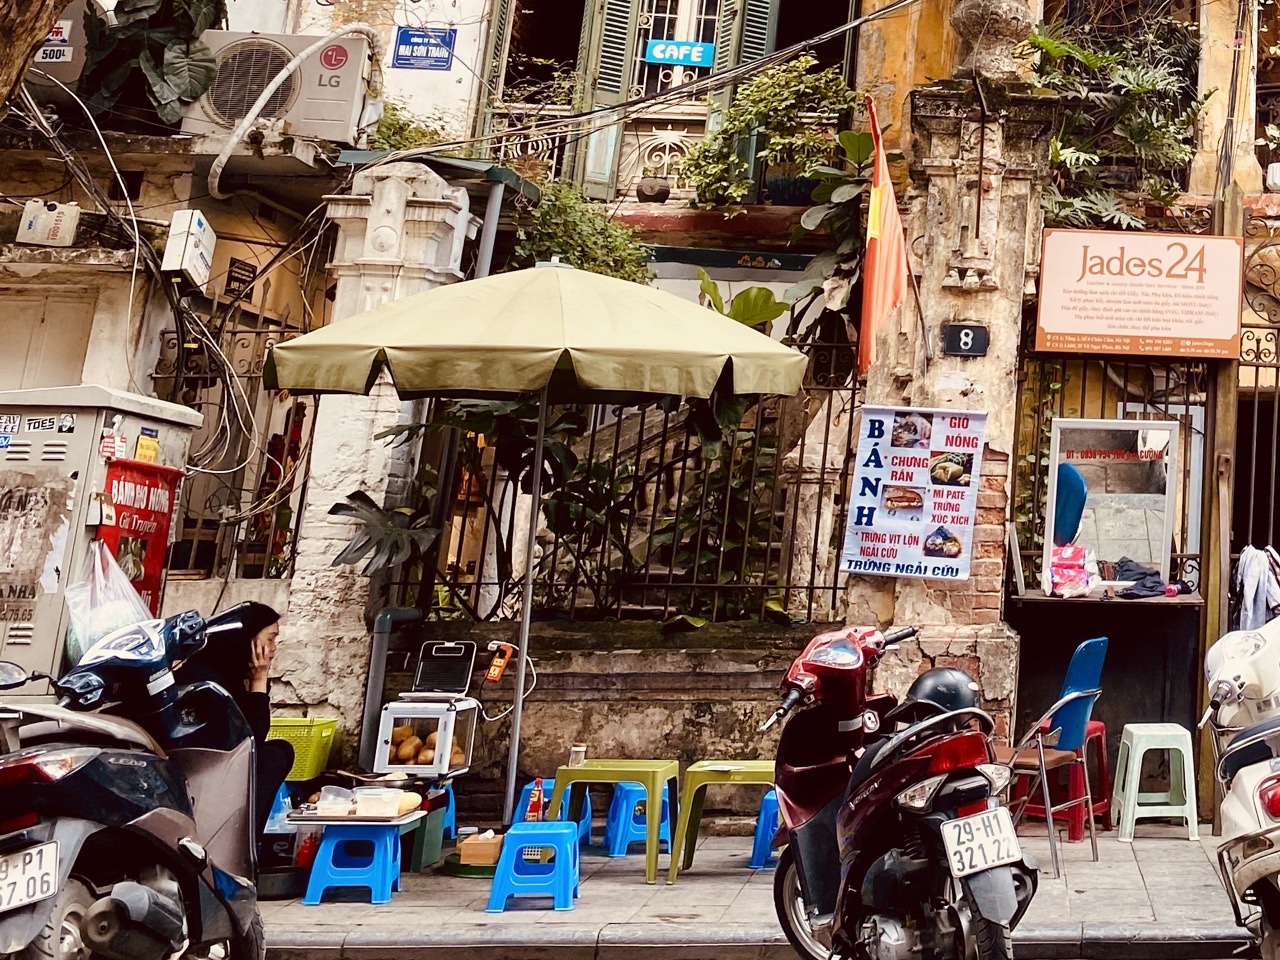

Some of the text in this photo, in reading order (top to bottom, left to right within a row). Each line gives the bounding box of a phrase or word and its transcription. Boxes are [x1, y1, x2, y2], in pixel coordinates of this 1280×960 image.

[652, 43, 704, 62] CAFÉ
[318, 74, 341, 88] LG
[1076, 242, 1207, 283] Jades24
[960, 329, 973, 350] 8
[945, 433, 979, 449] NÓNG
[890, 455, 929, 469] CHƯNG
[890, 470, 914, 482] RÁN
[946, 490, 966, 500] PATE
[931, 513, 948, 524] XÚC
[888, 533, 902, 546] VỊT
[847, 558, 960, 578] TRỨNG NGẢI CỨU
[952, 812, 1003, 847] 29-H1
[953, 836, 1015, 873] 321.22
[0, 872, 50, 907] 7.06
